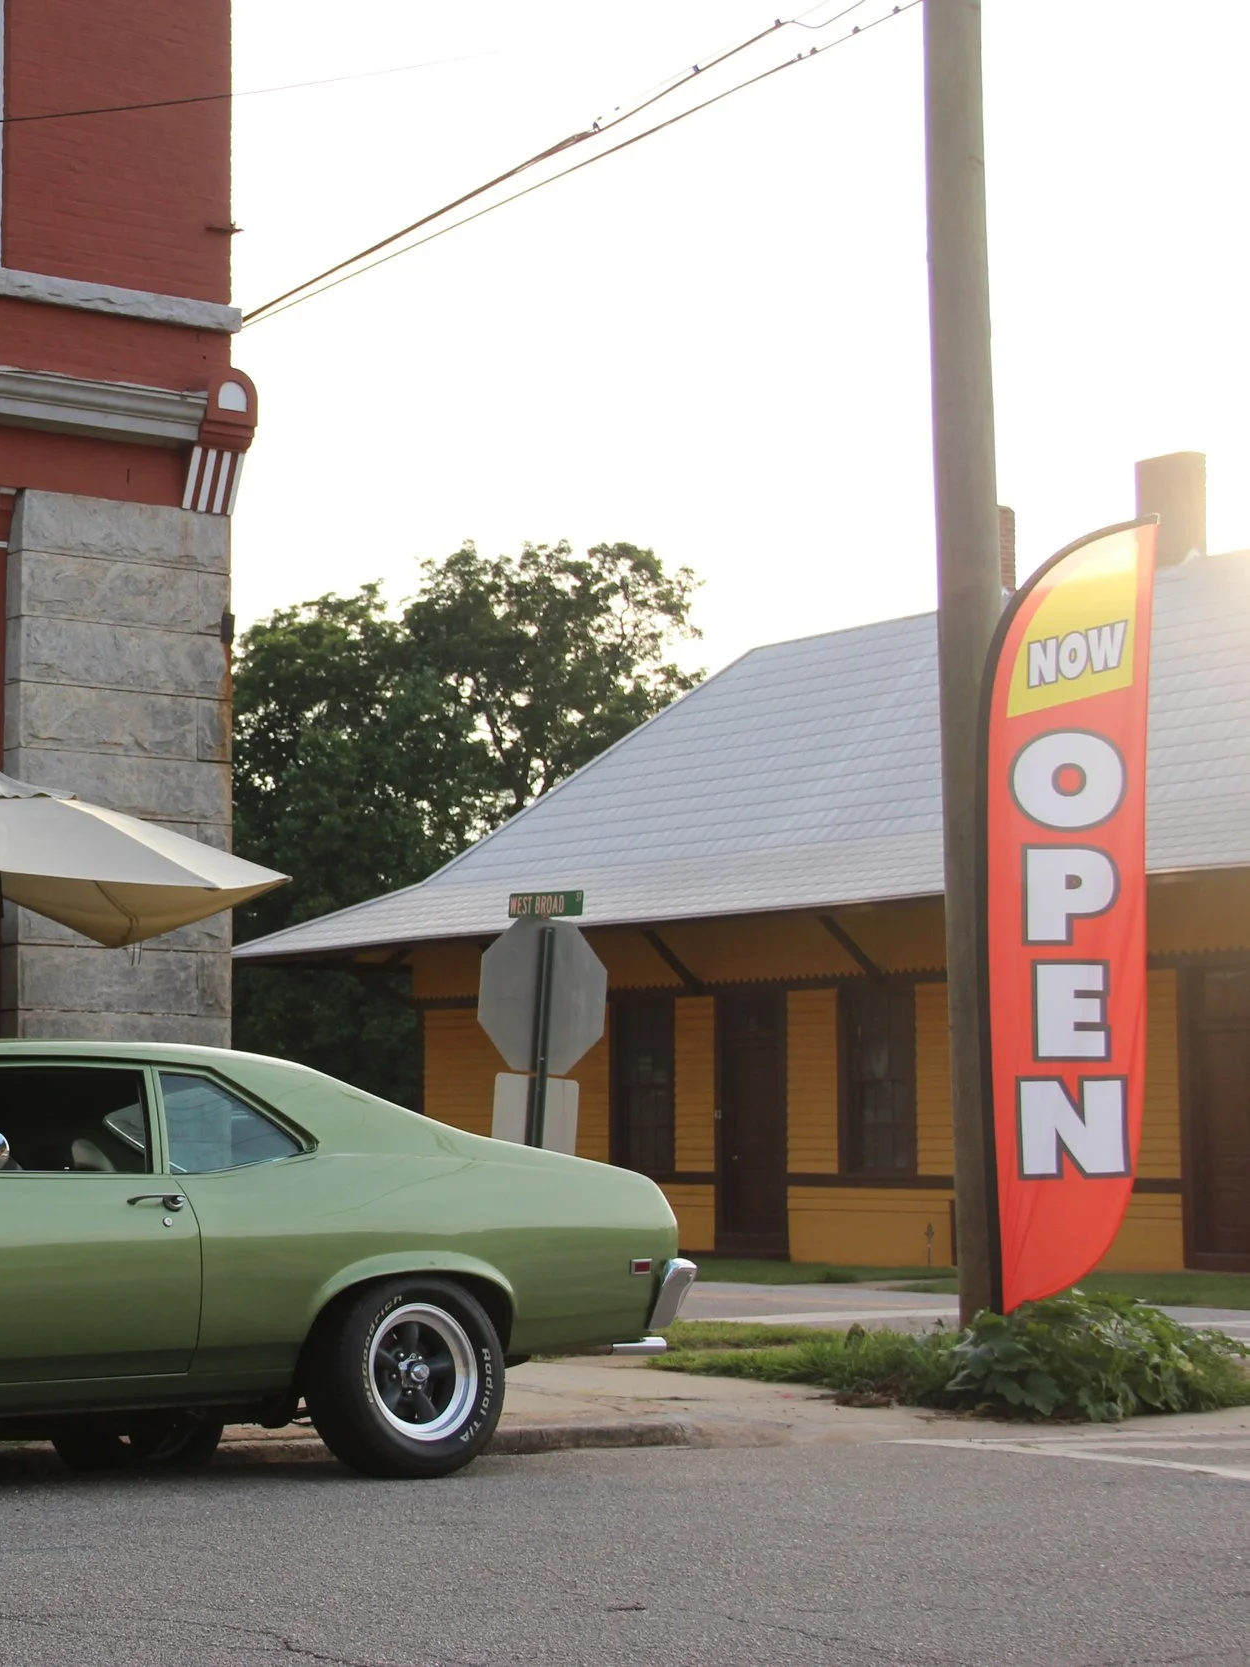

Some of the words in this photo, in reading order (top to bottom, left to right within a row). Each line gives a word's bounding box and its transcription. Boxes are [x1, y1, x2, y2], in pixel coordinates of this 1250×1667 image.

[1027, 619, 1128, 689] NOW
[510, 895, 532, 915] WEST
[535, 894, 565, 914] BROAD
[1007, 727, 1130, 1180] OPEN
[481, 1348, 494, 1416] Radial
[459, 1418, 482, 1443] T/A
